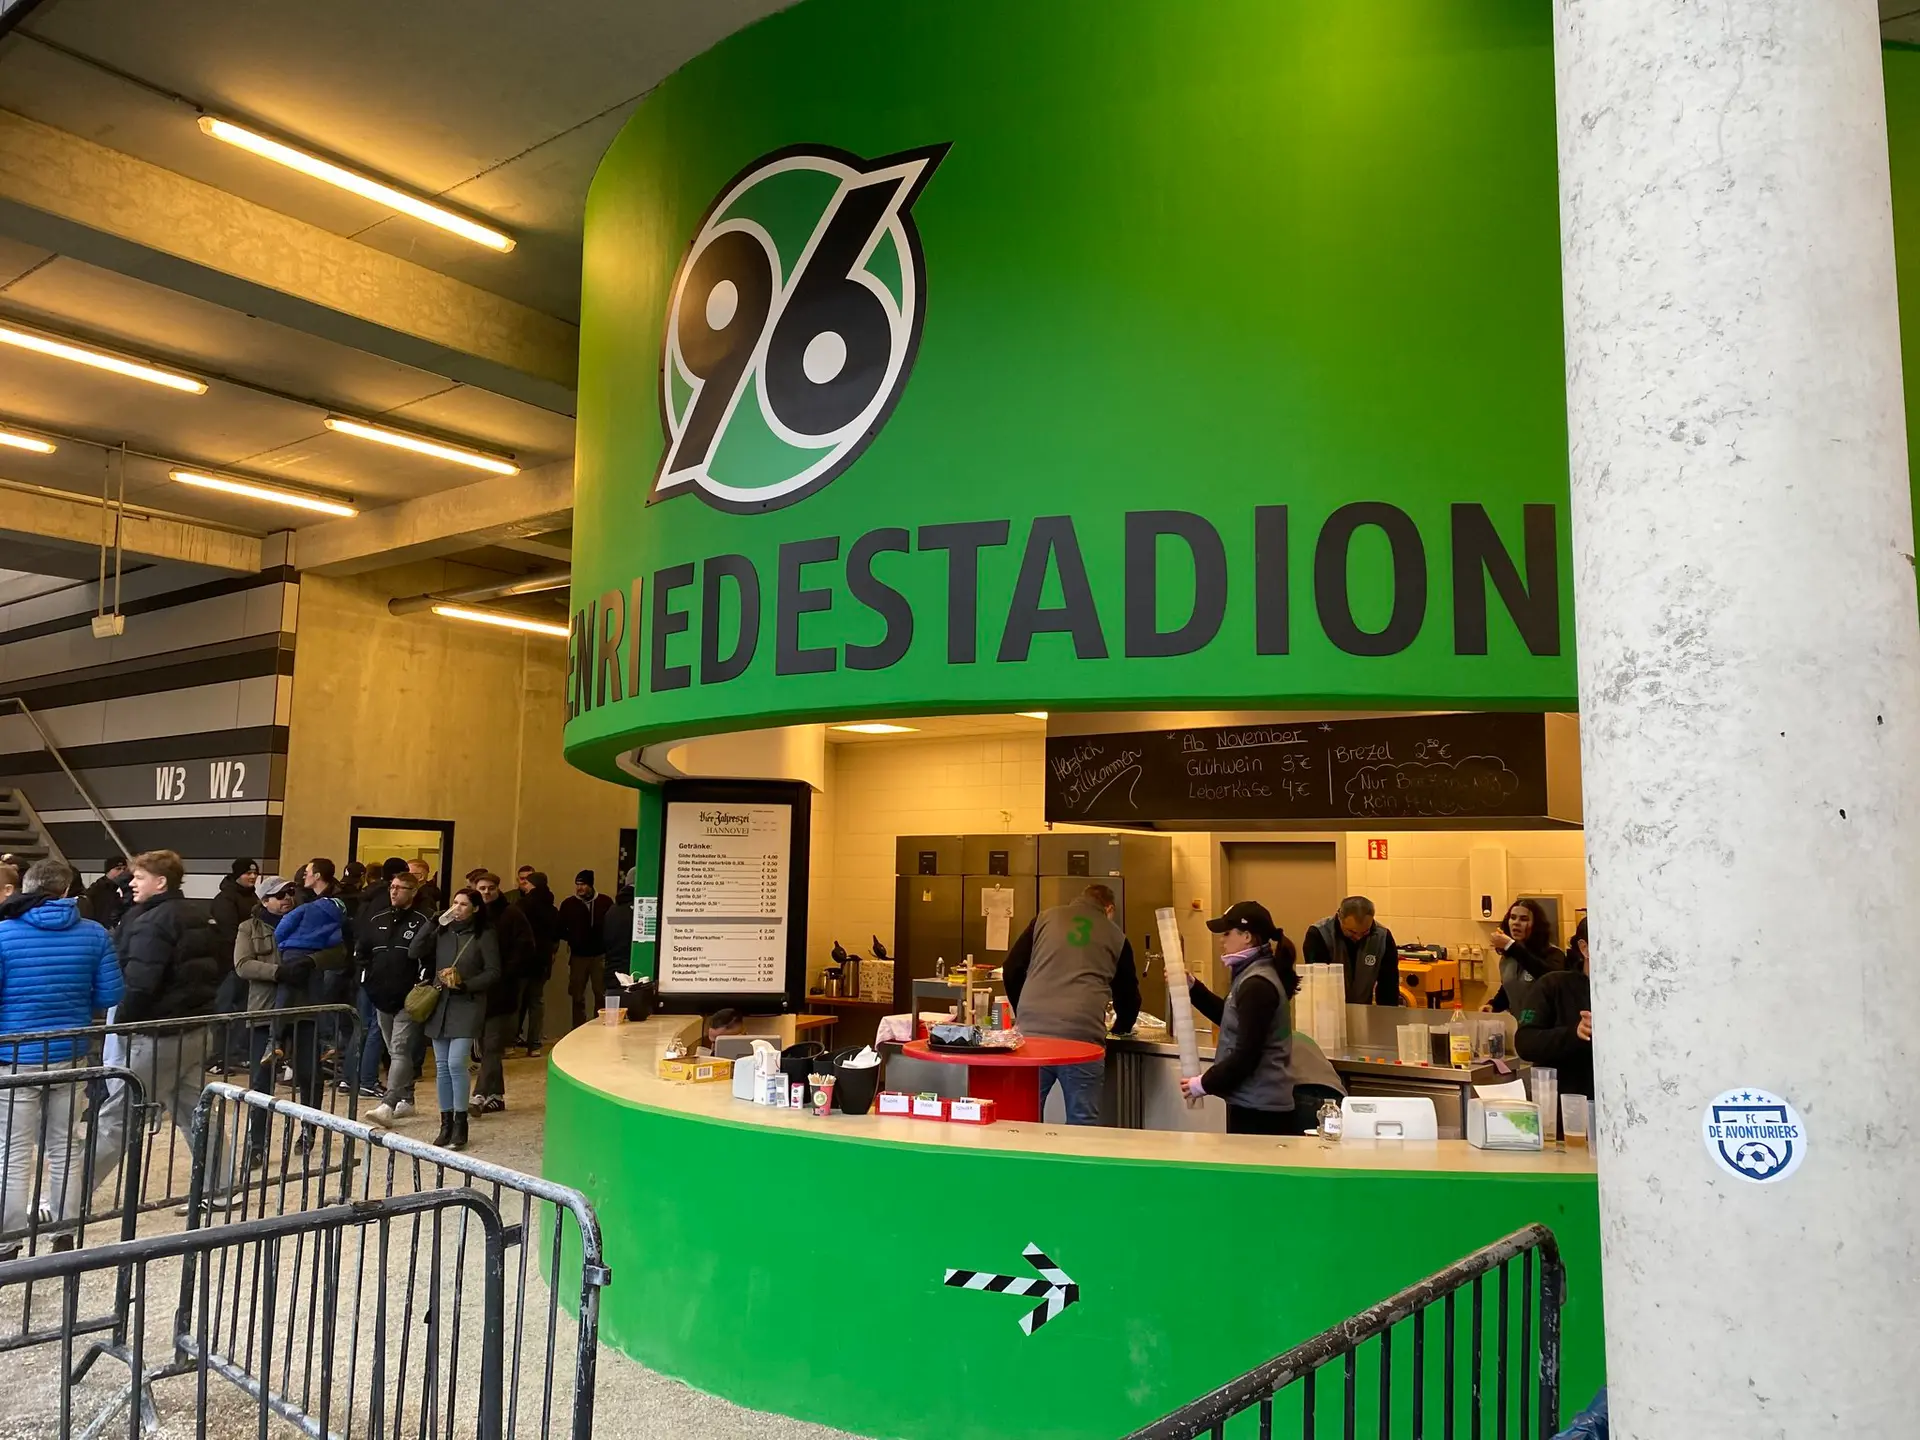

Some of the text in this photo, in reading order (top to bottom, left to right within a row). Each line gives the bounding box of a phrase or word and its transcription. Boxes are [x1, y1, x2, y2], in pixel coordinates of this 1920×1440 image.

[1183, 728, 1303, 751] Ab November
[1050, 744, 1104, 782] Herzlich
[1335, 741, 1395, 763] Brezel
[156, 761, 246, 802] W3 W2
[1360, 773, 1388, 790] Nur
[1067, 915, 1093, 947] 3
[1745, 1113, 1757, 1124] FC
[1708, 1125, 1799, 1138] DE AVONTURIERS
